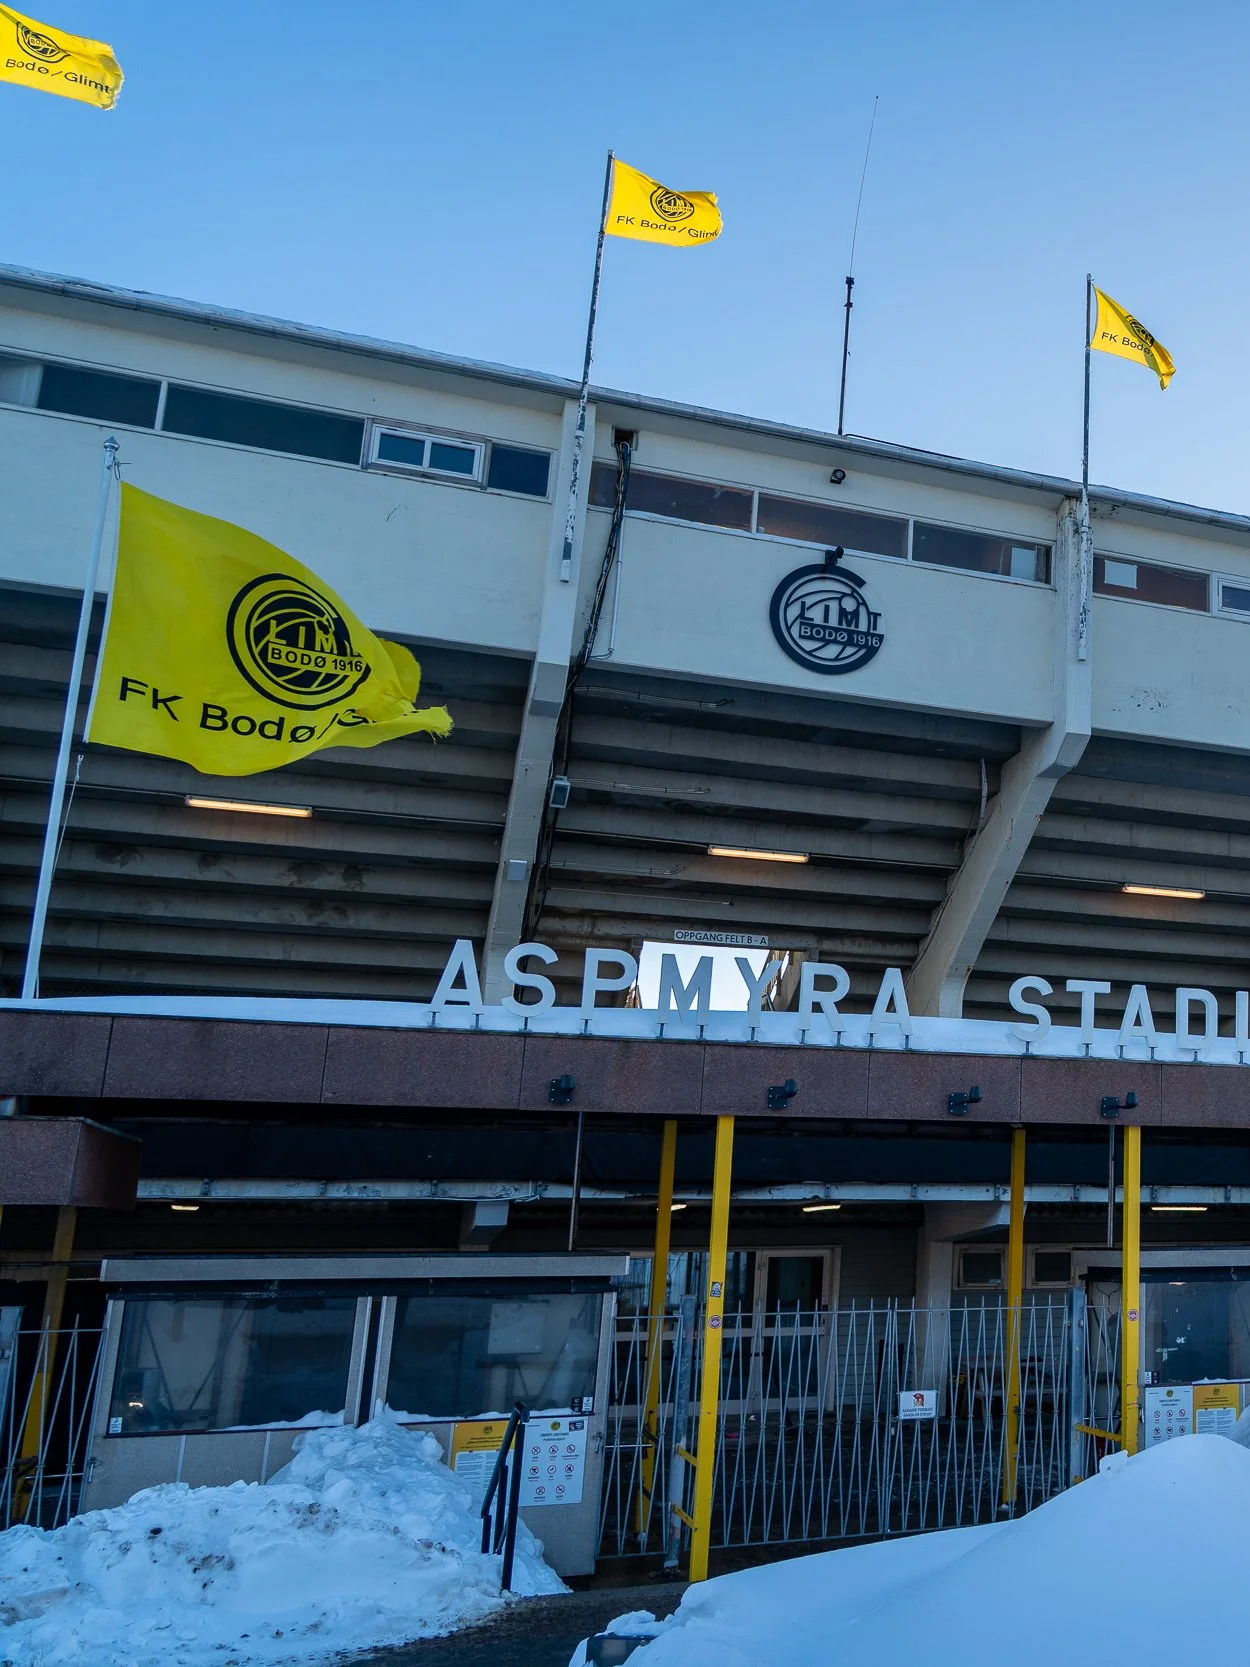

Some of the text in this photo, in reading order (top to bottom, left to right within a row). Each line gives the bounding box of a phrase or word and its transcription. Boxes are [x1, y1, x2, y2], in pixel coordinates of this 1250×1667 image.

[616, 215, 635, 226] FK
[1101, 332, 1118, 343] FK
[800, 625, 881, 648] BODØ 1916
[271, 647, 363, 673] BODØ 1916
[119, 676, 184, 722] FK
[675, 931, 723, 942] OPPGANG
[725, 934, 745, 943] FELT
[747, 935, 753, 944] B
[760, 936, 767, 945] A
[428, 939, 914, 1036] ASPMYRA
